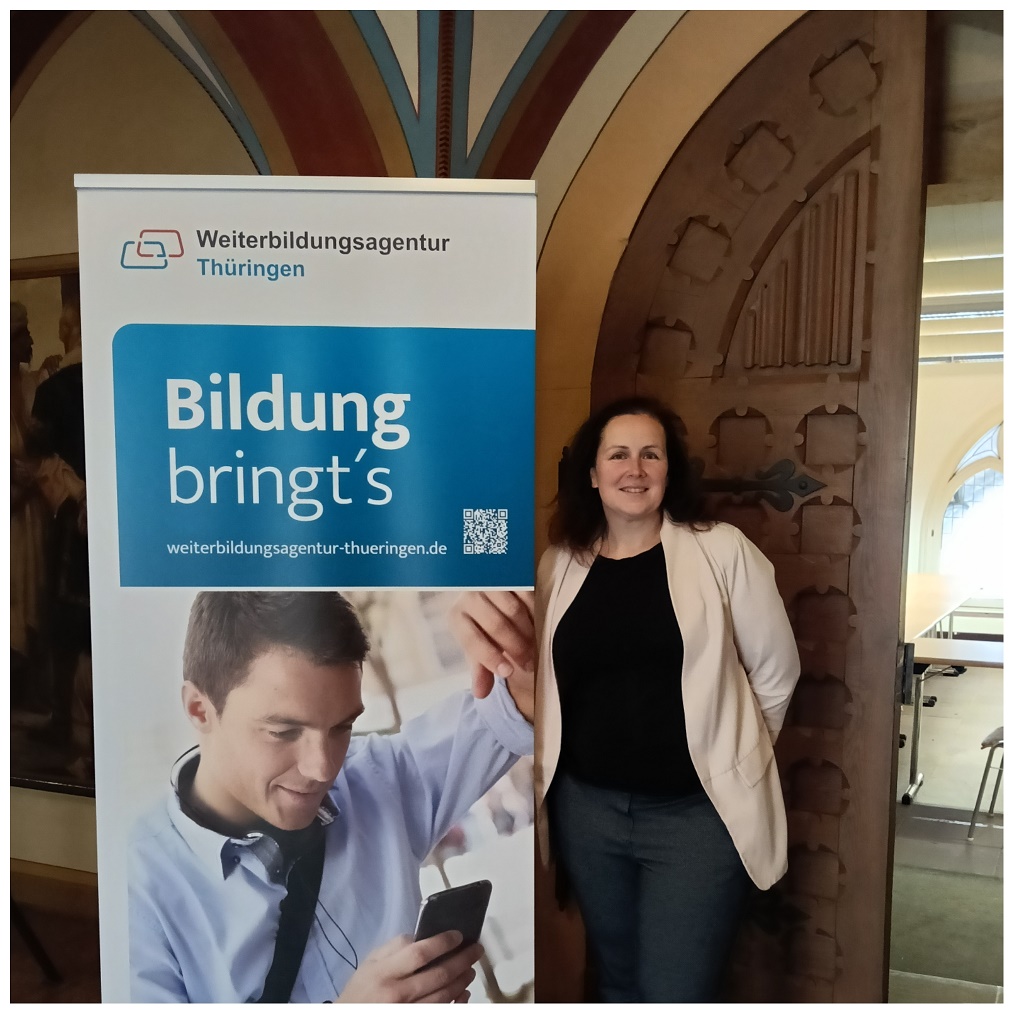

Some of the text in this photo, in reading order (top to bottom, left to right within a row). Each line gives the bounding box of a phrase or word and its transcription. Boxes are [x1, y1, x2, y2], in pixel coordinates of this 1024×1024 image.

[197, 229, 451, 254] Weiterbildungsagentur
[196, 258, 305, 281] Thüringen
[166, 373, 411, 450] Bildung
[166, 540, 447, 557] weiterbildungsagentur-thueringen.de
